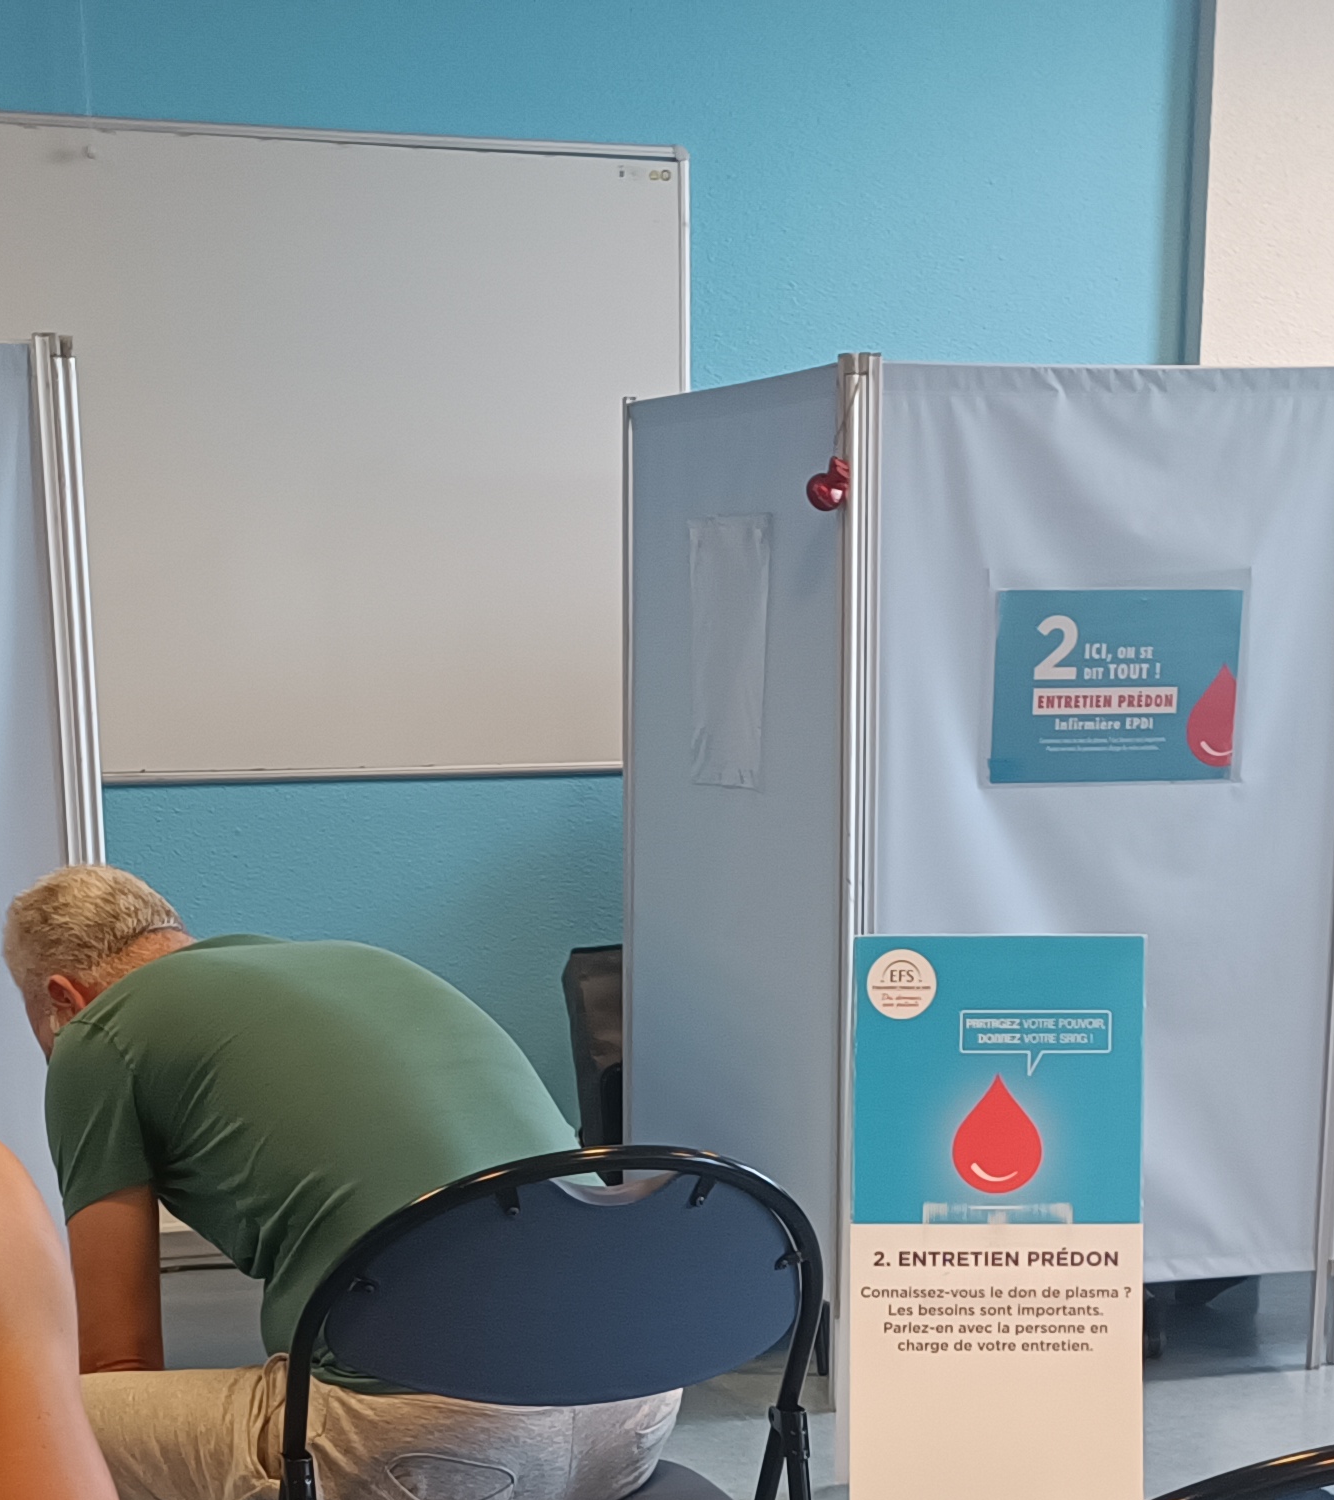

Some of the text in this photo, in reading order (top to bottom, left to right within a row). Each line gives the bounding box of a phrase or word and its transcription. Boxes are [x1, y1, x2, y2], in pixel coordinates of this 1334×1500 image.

[1033, 614, 1079, 681] 2
[1084, 643, 1154, 662] ICI, ON SE
[1083, 662, 1161, 680] DIT TOUT !
[1037, 691, 1174, 709] ENTRETIEN PRÉDON
[1054, 717, 1154, 731] Infirmière EPDI
[889, 969, 915, 983] EFS
[966, 1018, 1021, 1029] PARTAGEZ
[1023, 1018, 1056, 1029] VOTRE
[977, 1033, 1021, 1044] DONNEZ
[1023, 1033, 1056, 1044] VOTRE
[873, 1247, 1119, 1267] 2. ENTRETIEN PRÉDON
[860, 1286, 1132, 1302] Connaissez-vous le don de plasma ?
[888, 1304, 1104, 1319] Les besoins sont importants.
[883, 1322, 1108, 1336] Parlez-en avec la personne en
[897, 1339, 1094, 1354] charge de votre entretien.
